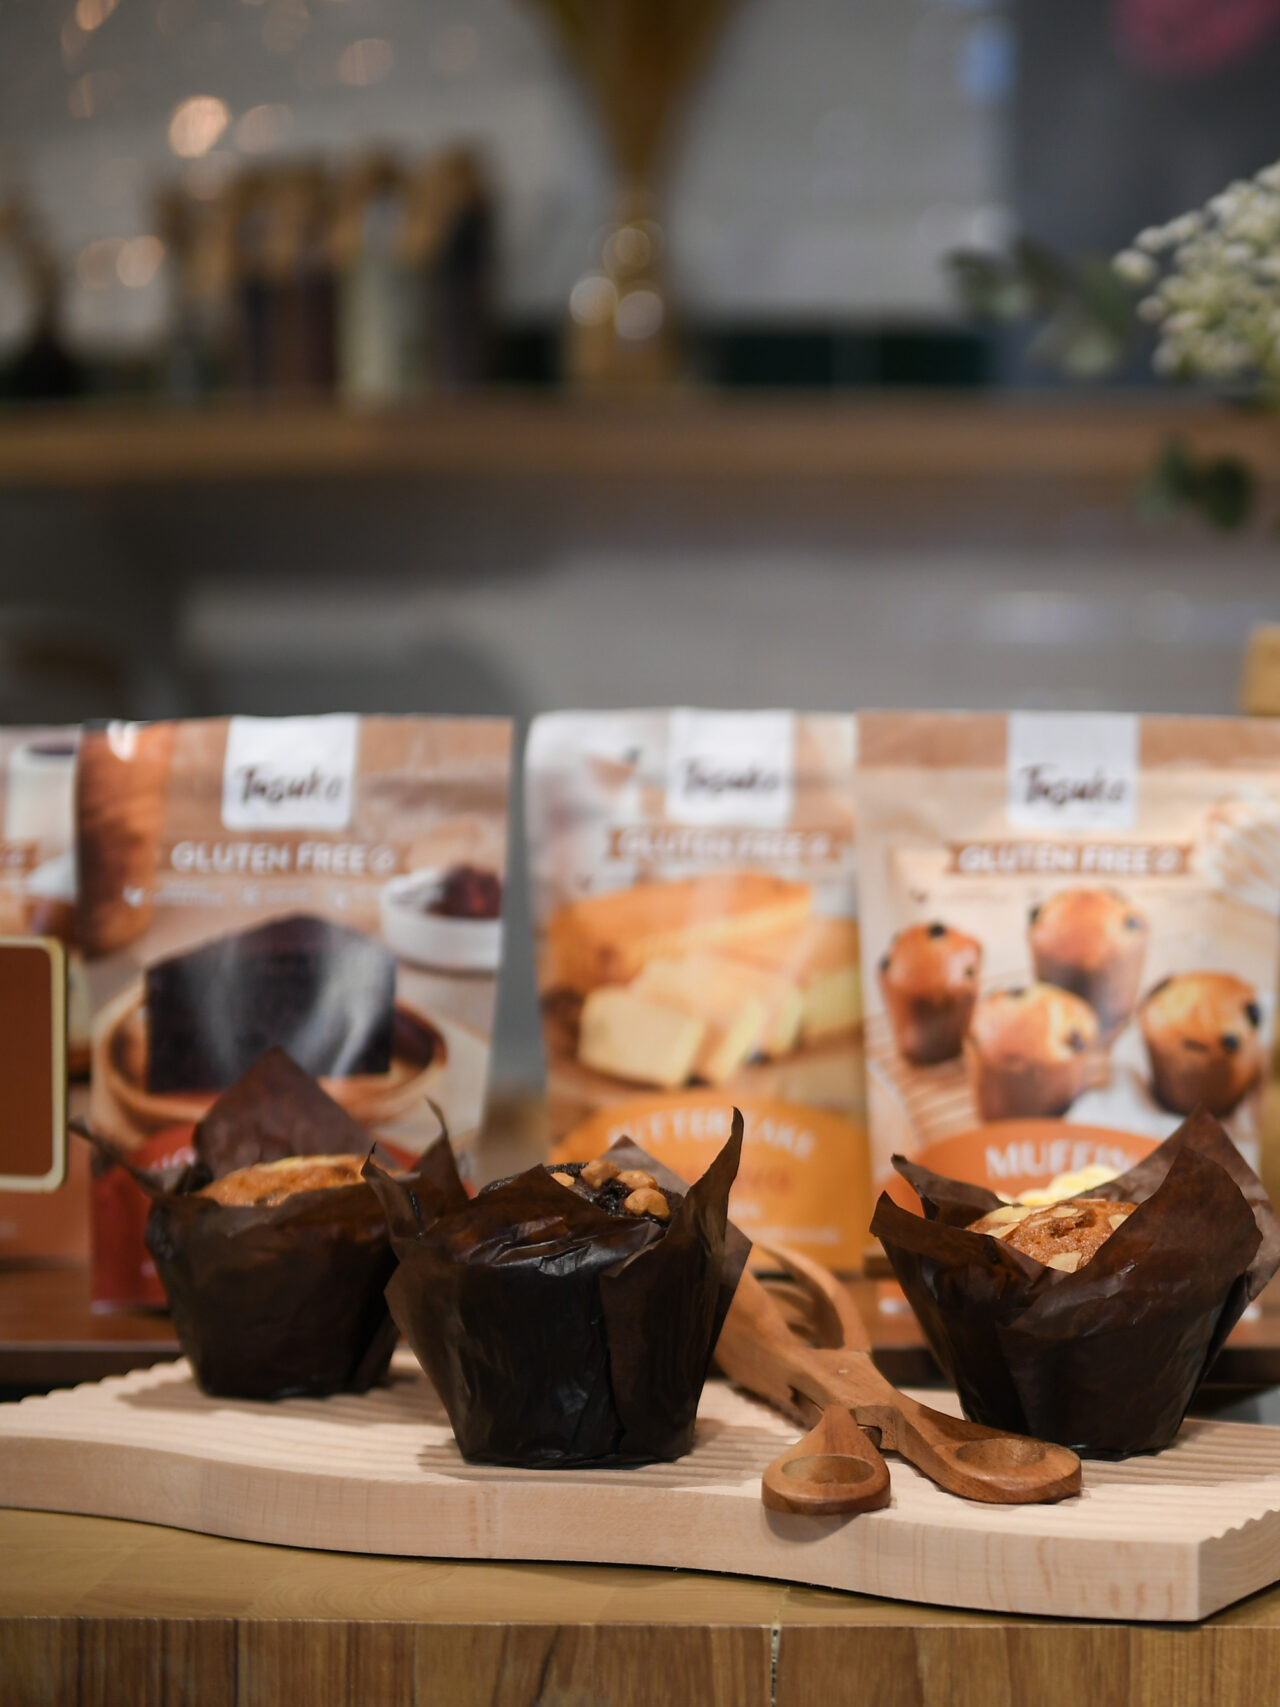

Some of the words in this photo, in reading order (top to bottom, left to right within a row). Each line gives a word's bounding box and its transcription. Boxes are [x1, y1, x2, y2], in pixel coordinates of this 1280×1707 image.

[171, 840, 289, 875] GLUTEN
[297, 841, 366, 876] FREE
[959, 845, 1076, 874] GLUTEN
[1082, 844, 1150, 873] FREE
